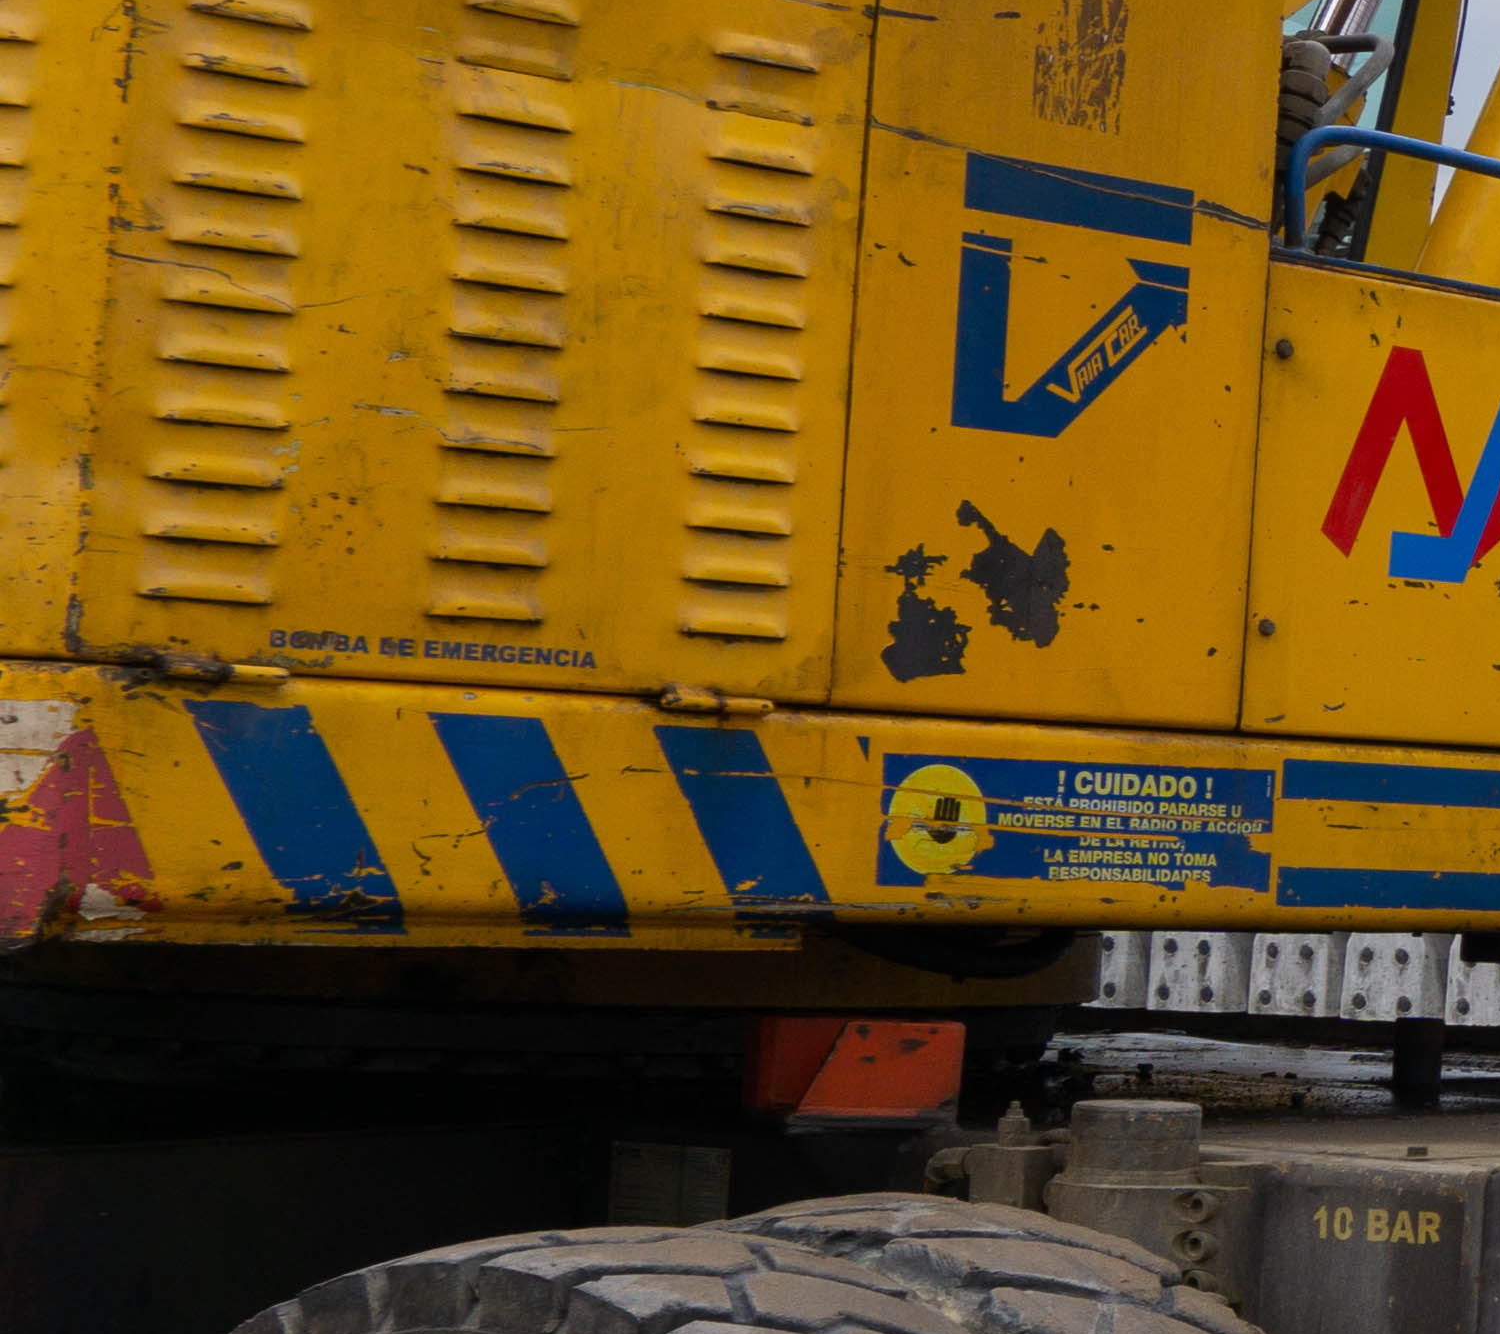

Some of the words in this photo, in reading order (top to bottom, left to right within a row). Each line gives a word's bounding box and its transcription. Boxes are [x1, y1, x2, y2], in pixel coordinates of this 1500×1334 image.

[424, 640, 597, 669] EMERGENCIA
[1074, 770, 1197, 799] CUIDADO
[1069, 797, 1154, 814] PROHIBIDO
[1158, 801, 1227, 817] PARARSE
[1231, 805, 1242, 817] U
[998, 813, 1075, 828] MOVERSE
[1080, 815, 1100, 829] EN
[1106, 816, 1124, 829] EL
[1129, 818, 1177, 832] RADIO
[1182, 819, 1201, 833] DE
[1044, 849, 1063, 863] LA
[1069, 850, 1141, 865] EMPRESA
[1148, 851, 1169, 866] NO
[1175, 853, 1216, 867] TOMA
[1049, 866, 1211, 883] RESPONSABILIDADES
[1313, 1205, 1354, 1241] 10
[1367, 1208, 1441, 1244] BAR
